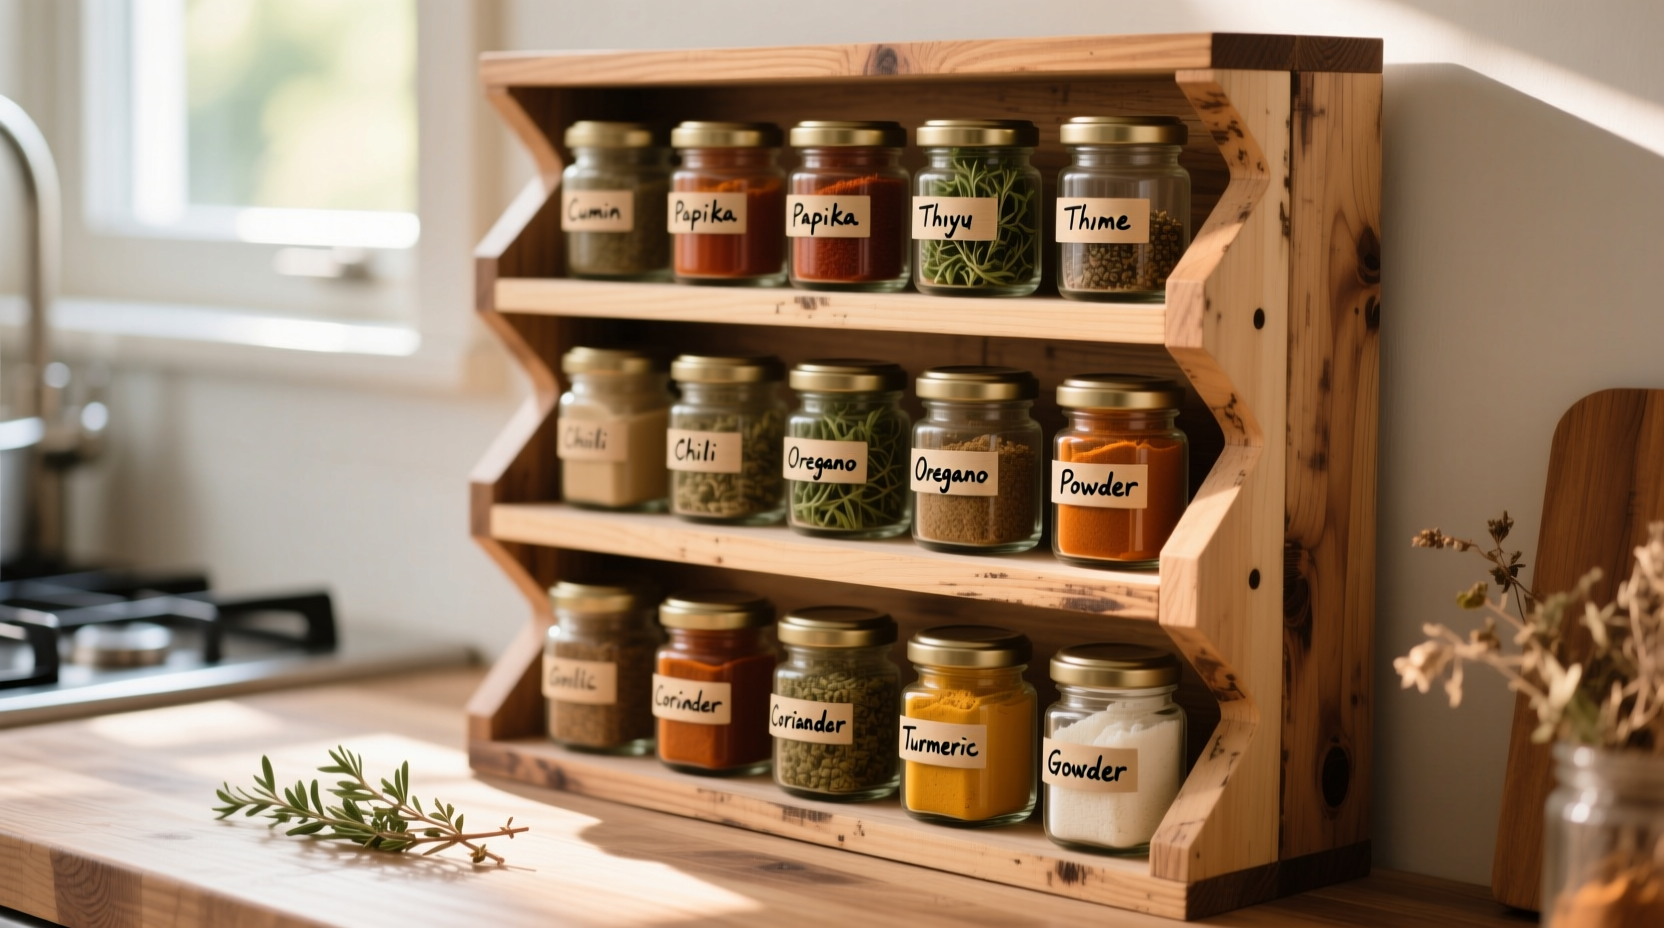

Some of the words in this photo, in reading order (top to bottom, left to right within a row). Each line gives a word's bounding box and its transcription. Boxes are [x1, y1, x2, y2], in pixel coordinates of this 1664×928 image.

[567, 197, 621, 222] Cumin
[674, 199, 737, 231] Papika
[792, 202, 859, 235] Papika
[918, 203, 973, 239] Thiyu
[1063, 204, 1131, 231] Thime
[674, 438, 717, 462] Chili
[787, 446, 857, 481] Oregano
[915, 456, 988, 494] Oregano
[1060, 468, 1139, 498] Powder
[655, 684, 722, 714] Corinder
[771, 704, 847, 734] Coriander
[902, 725, 979, 757] Turmeric
[1047, 749, 1127, 782] Gowder
